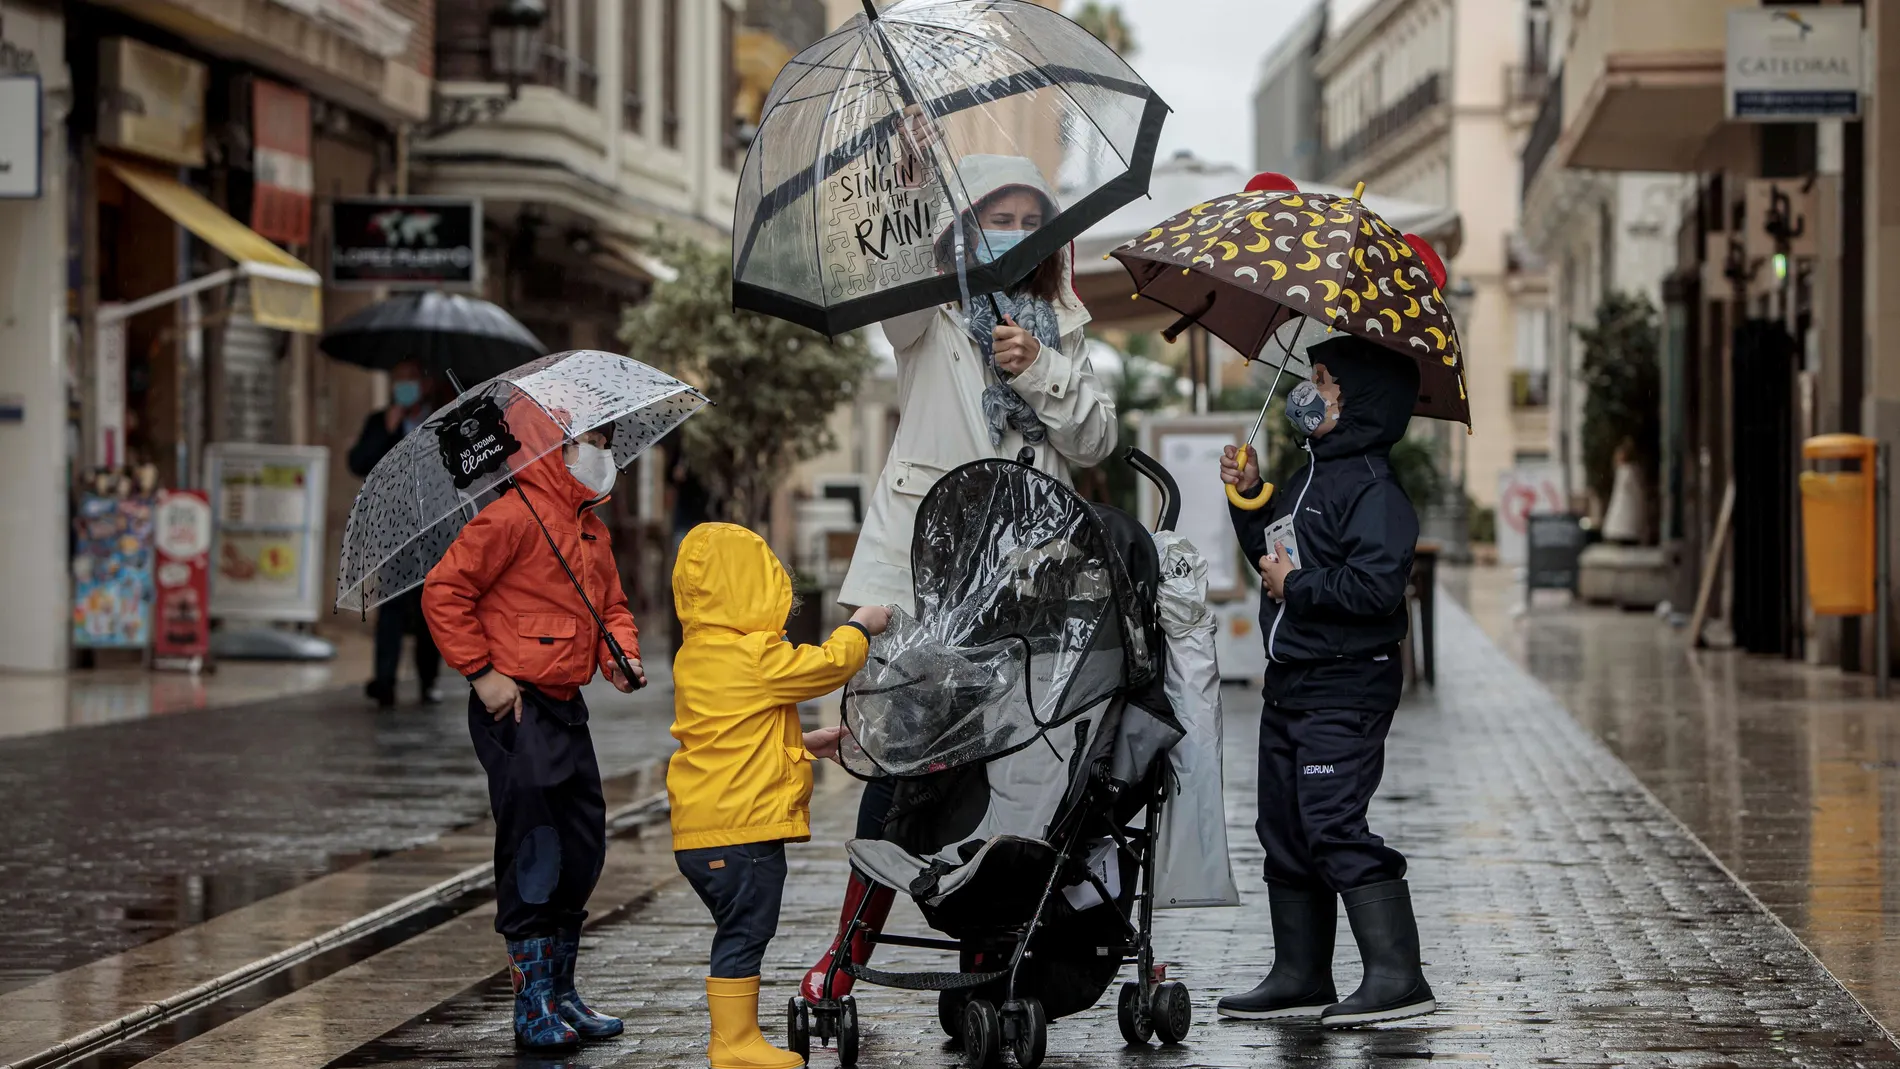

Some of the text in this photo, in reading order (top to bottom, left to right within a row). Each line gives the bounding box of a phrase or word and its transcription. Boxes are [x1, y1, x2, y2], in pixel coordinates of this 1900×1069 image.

[1736, 56, 1851, 77] CATEDRAL
[862, 139, 892, 170] I'M
[866, 191, 911, 217] IN THE
[855, 199, 932, 260] RAIN!
[460, 434, 496, 459] NO DRAMA
